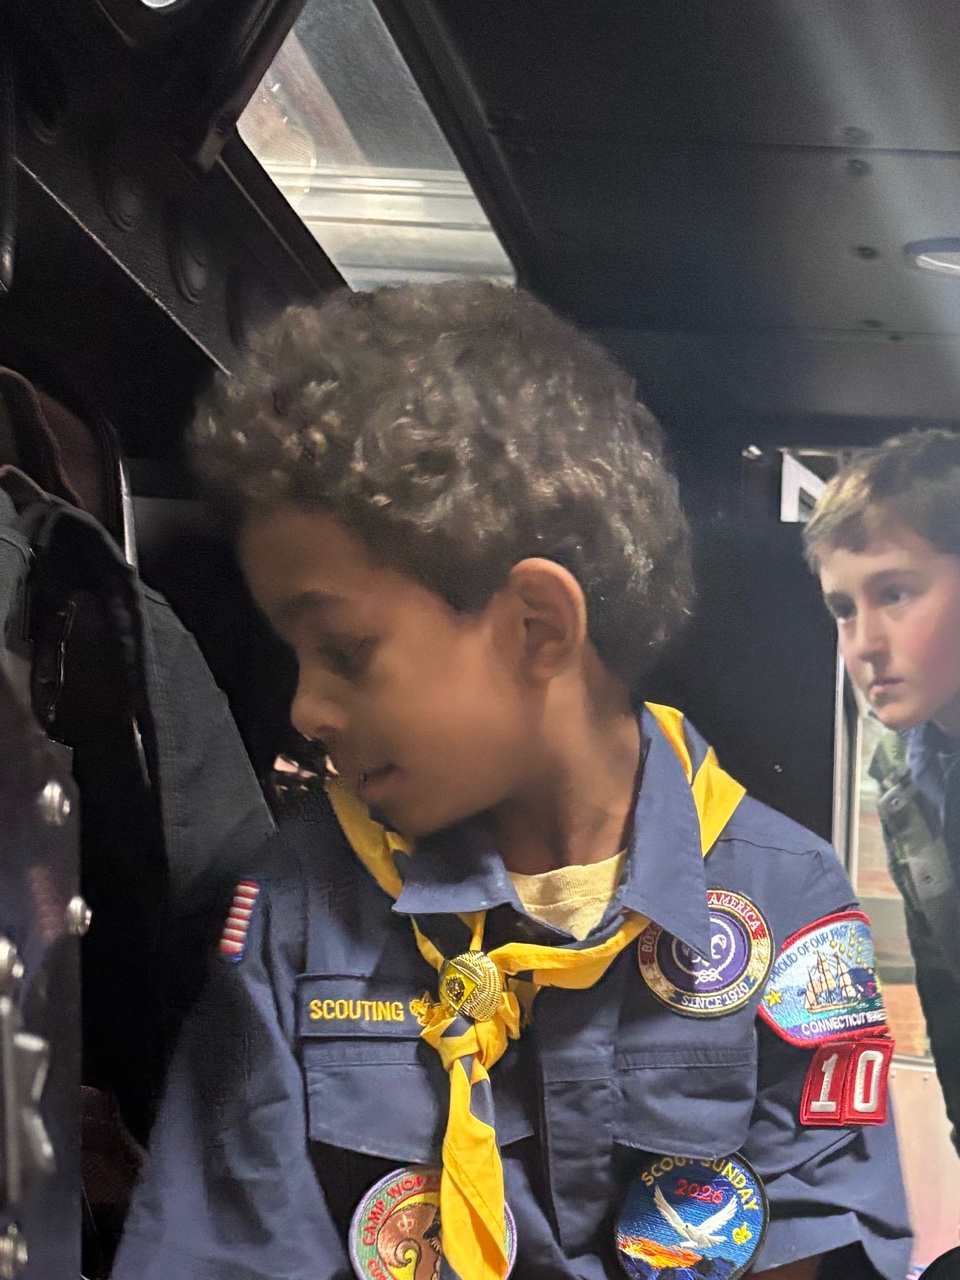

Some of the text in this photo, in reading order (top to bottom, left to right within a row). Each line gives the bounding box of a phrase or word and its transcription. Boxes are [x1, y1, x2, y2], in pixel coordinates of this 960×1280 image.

[641, 894, 760, 953] BOY AMERICA
[769, 952, 798, 983] PROUD
[799, 941, 811, 956] OF
[810, 932, 831, 949] OUR
[681, 982, 750, 1009] SINCE 1910
[309, 999, 405, 1021] SCOUTING
[801, 1011, 866, 1036] CONNECTICUT
[641, 1157, 694, 1187] SCOU
[674, 1178, 724, 1205] 2026
[362, 1199, 386, 1246] CAMP
